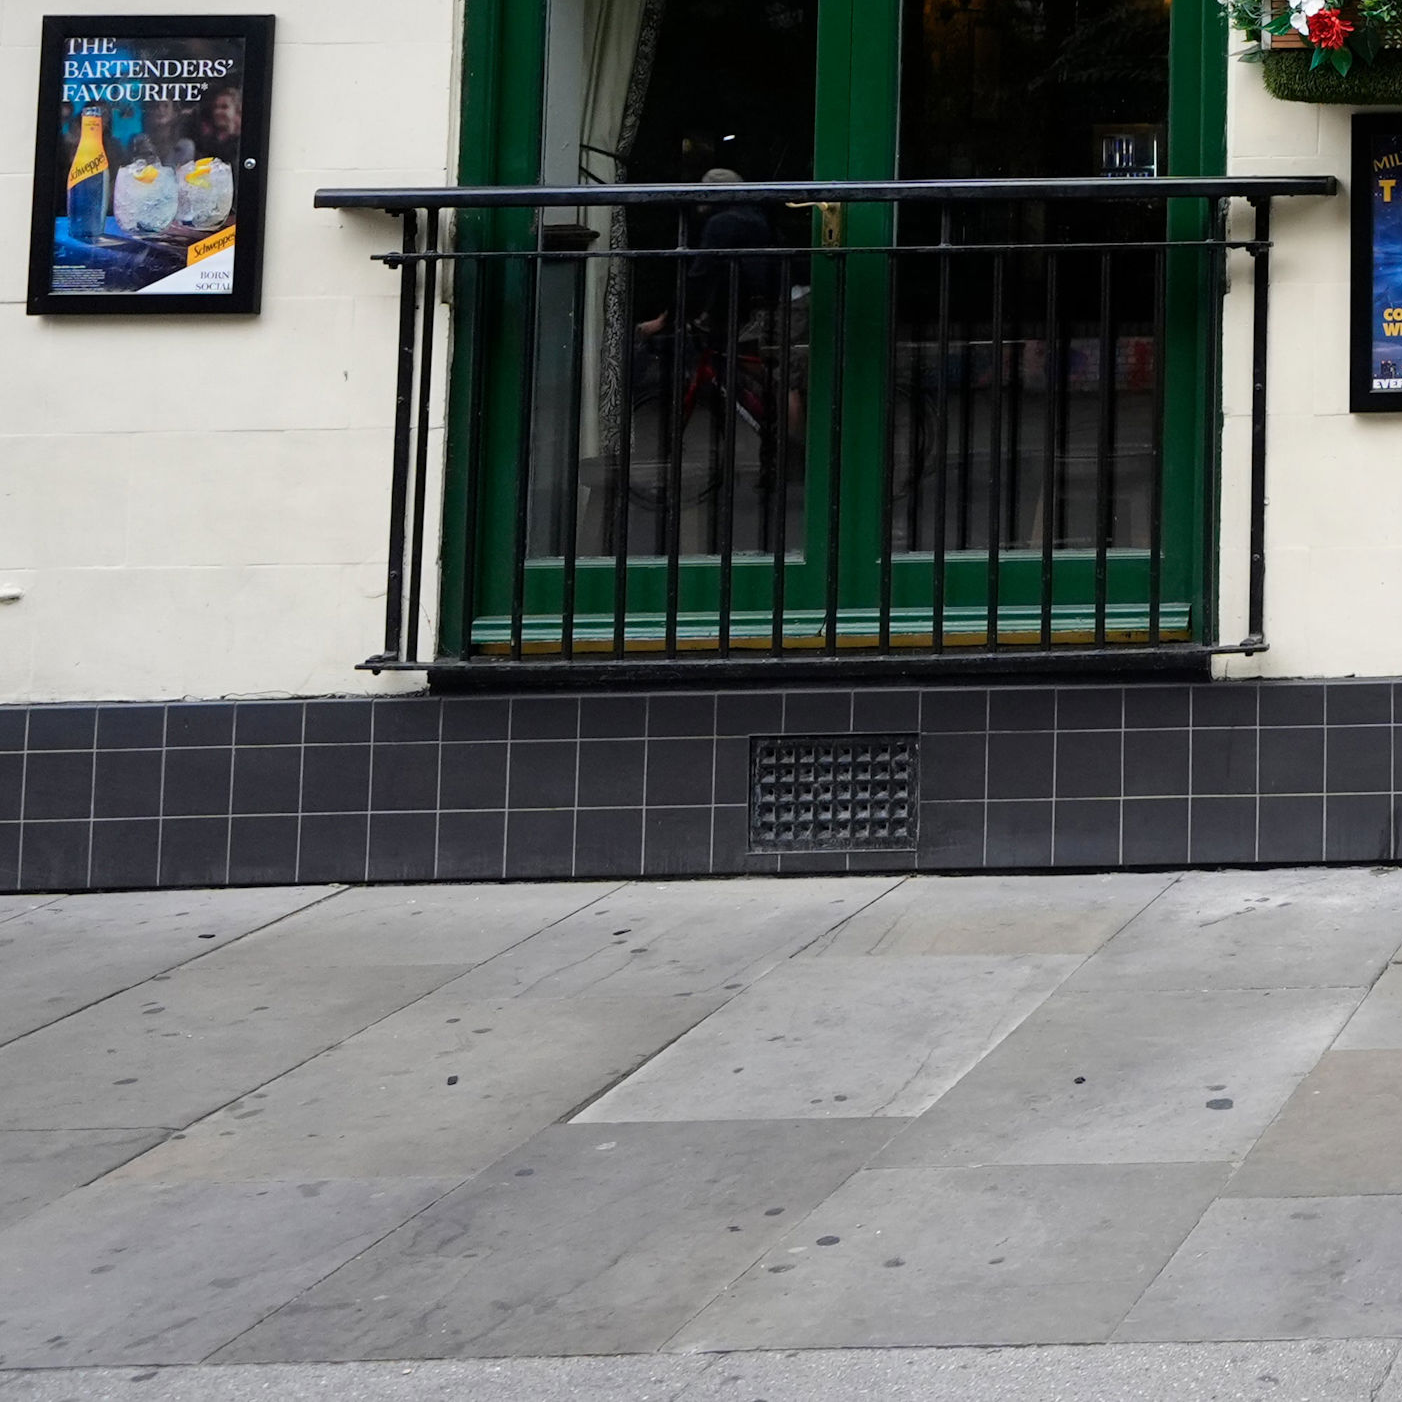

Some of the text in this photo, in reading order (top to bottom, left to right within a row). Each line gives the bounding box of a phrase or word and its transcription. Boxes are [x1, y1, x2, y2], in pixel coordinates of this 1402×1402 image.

[64, 37, 117, 56] THE
[62, 59, 234, 79] BARTENDERS'
[200, 271, 230, 280] BORN
